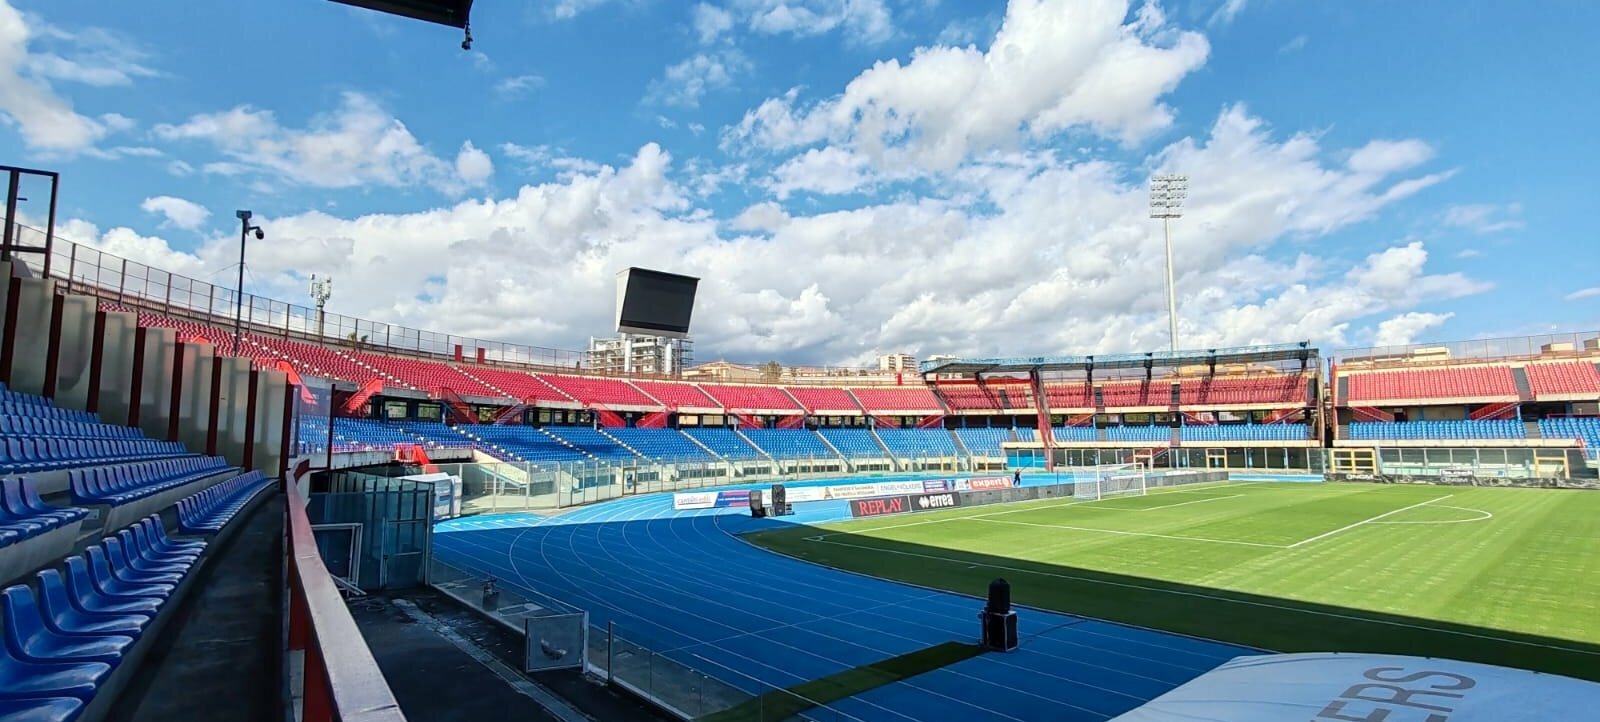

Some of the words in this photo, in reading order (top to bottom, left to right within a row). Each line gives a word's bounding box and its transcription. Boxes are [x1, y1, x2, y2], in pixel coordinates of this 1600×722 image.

[972, 478, 1002, 488] expert
[858, 498, 903, 516] REPLAY
[1311, 667, 1477, 722] ERS
